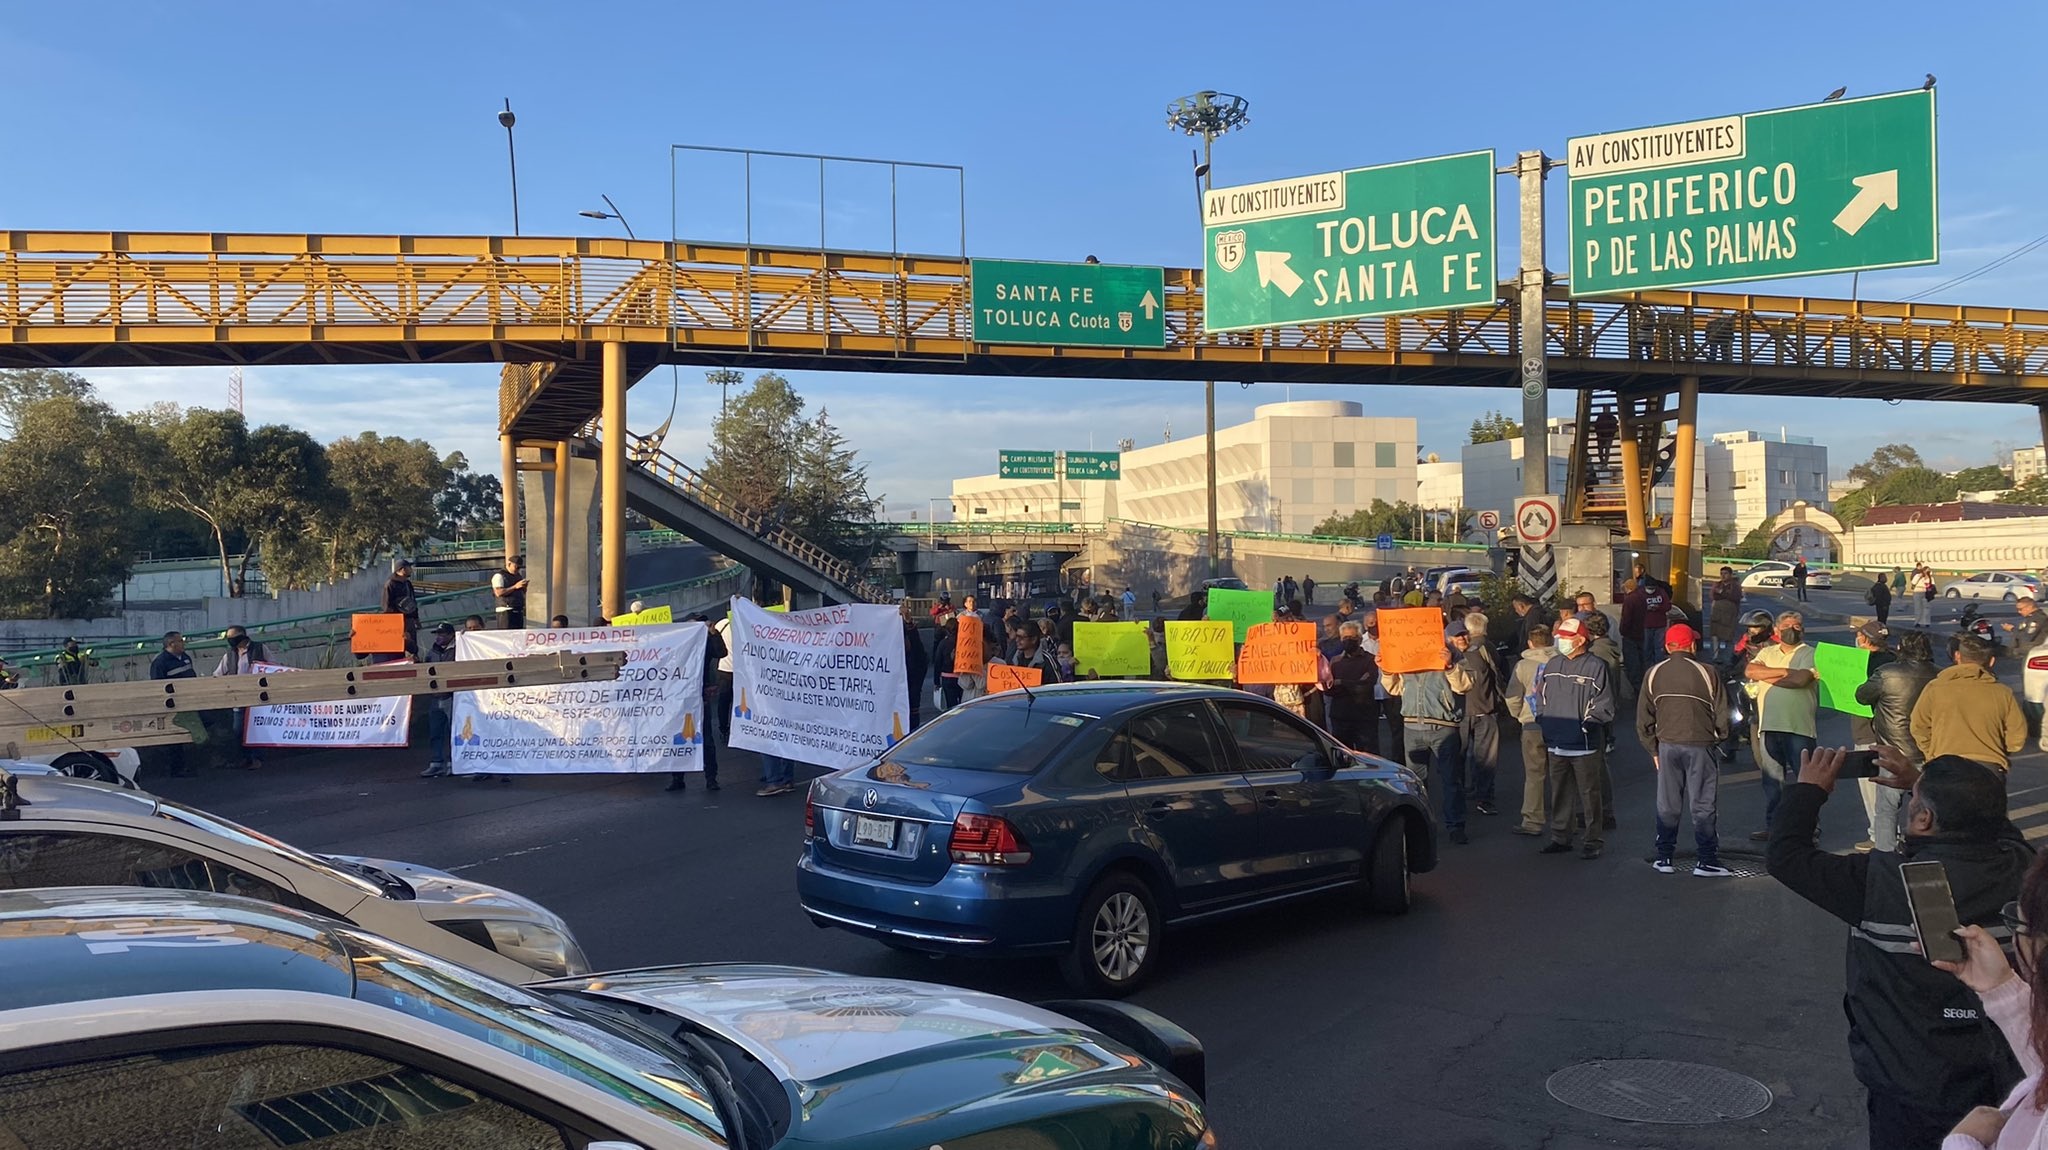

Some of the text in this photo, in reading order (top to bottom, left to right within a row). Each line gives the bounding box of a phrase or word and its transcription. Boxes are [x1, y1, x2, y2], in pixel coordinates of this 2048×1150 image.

[1576, 125, 1734, 168] AV CONSTITUYENTES
[1209, 180, 1336, 217] AV CONSTITUYENTES
[1585, 162, 1796, 226] PERIFERICO
[1316, 204, 1478, 257] TOLUCA
[1223, 245, 1237, 262] 15
[1587, 217, 1797, 278] P DE LAS PALMAS
[1313, 252, 1482, 307] SANTA FE
[996, 284, 1093, 303] SANTA FE
[984, 309, 1110, 329] TOLUCA Cuota
[1121, 319, 1130, 328] 15
[526, 629, 639, 646] POR CULPA DEL
[1181, 626, 1226, 644] BASTA
[1182, 645, 1200, 657] DE
[769, 647, 812, 667] CUMPLIR
[812, 654, 875, 672] ACUERDOS
[876, 658, 891, 673] AL
[1240, 659, 1314, 676] TARIFA CDMX
[671, 666, 690, 681] AL
[819, 676, 836, 691] DE
[491, 688, 667, 705] INCREMENTO DE TARIFA.
[803, 693, 825, 708] ESTE
[270, 704, 282, 714] NO
[284, 704, 312, 715] PEDIMOS
[334, 705, 344, 715] DE
[486, 709, 512, 721] NOS
[562, 707, 591, 719] ESTE
[253, 716, 284, 726] PEDIMOS
[309, 717, 344, 728] TENEMOS
[360, 717, 369, 726] DE
[282, 730, 361, 741] CON LA MISMA TARIFA
[482, 737, 536, 748] CIUDADANIA
[538, 737, 558, 747] UNA
[559, 736, 605, 747] DISCULPA
[606, 735, 626, 746] POR
[627, 735, 639, 745] EL
[790, 732, 820, 748] TENEMOS
[806, 723, 840, 738] DISCULPA
[851, 731, 860, 743] EL
[490, 749, 530, 760] TAMBIEN
[531, 749, 577, 759] TENEMOS
[578, 748, 613, 759] FAMILIA
[614, 748, 635, 758] QUE
[1943, 1007, 1979, 1019] SEGUR.
